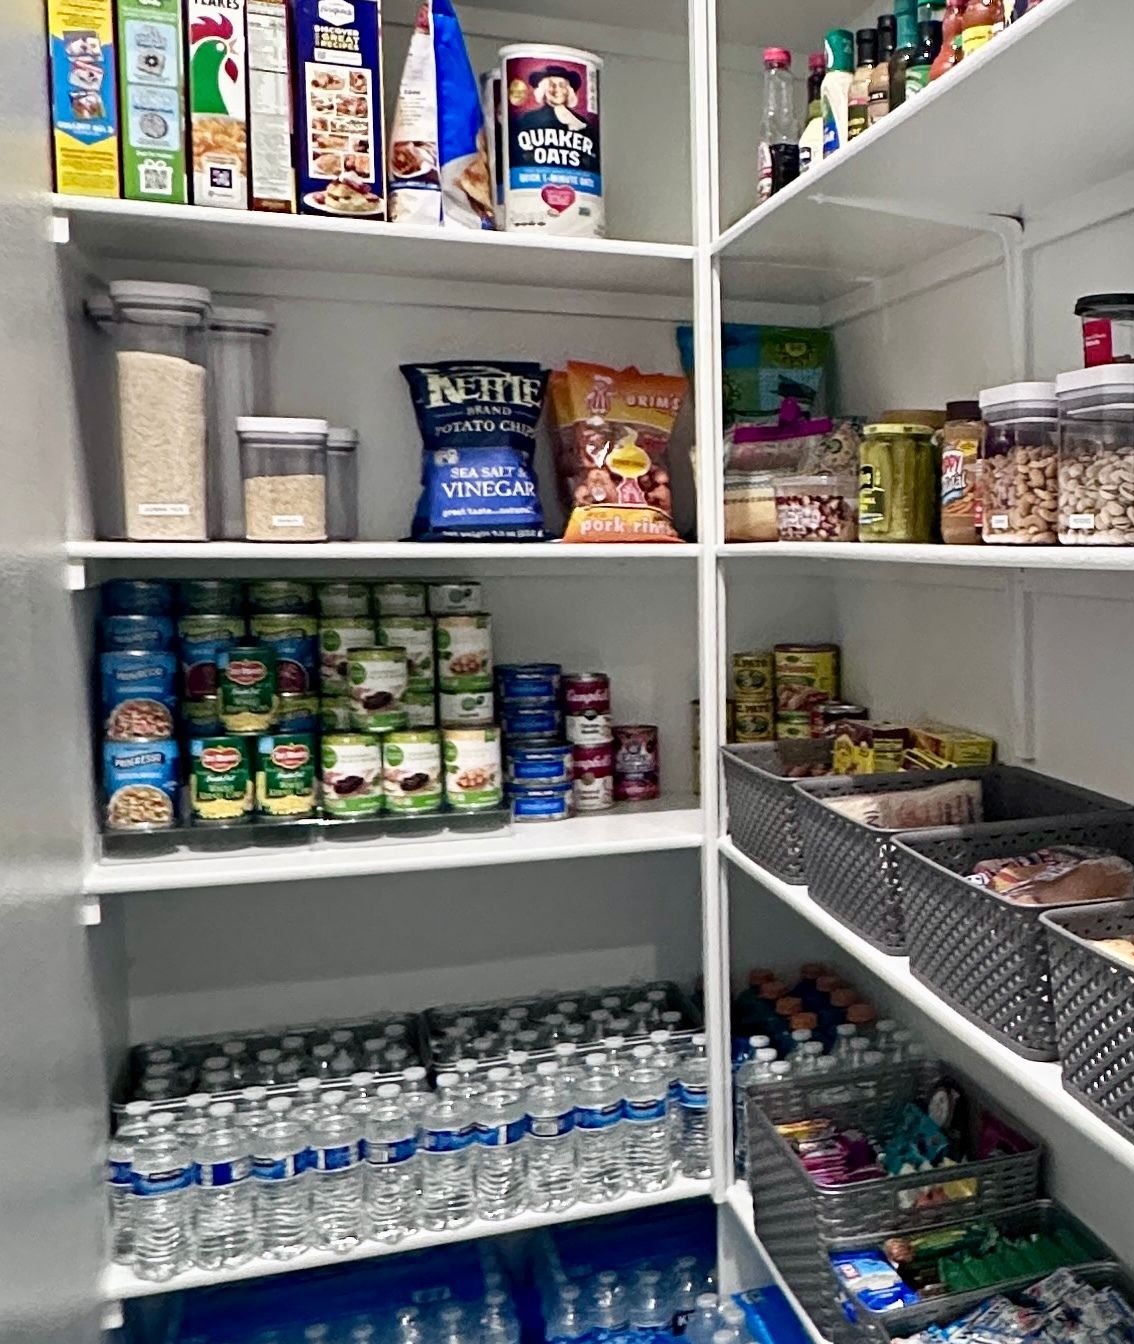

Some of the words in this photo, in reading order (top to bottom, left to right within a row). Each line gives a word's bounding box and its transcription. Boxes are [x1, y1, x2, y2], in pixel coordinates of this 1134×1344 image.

[517, 128, 594, 156] QUAKER
[534, 147, 581, 167] OATS
[427, 368, 543, 408] KETTLE
[466, 404, 512, 417] BRAND
[435, 418, 496, 437] POTATO
[450, 466, 480, 479] SEA
[481, 466, 515, 479] SALT
[441, 480, 537, 499] VINEGAR
[580, 515, 626, 538] pork
